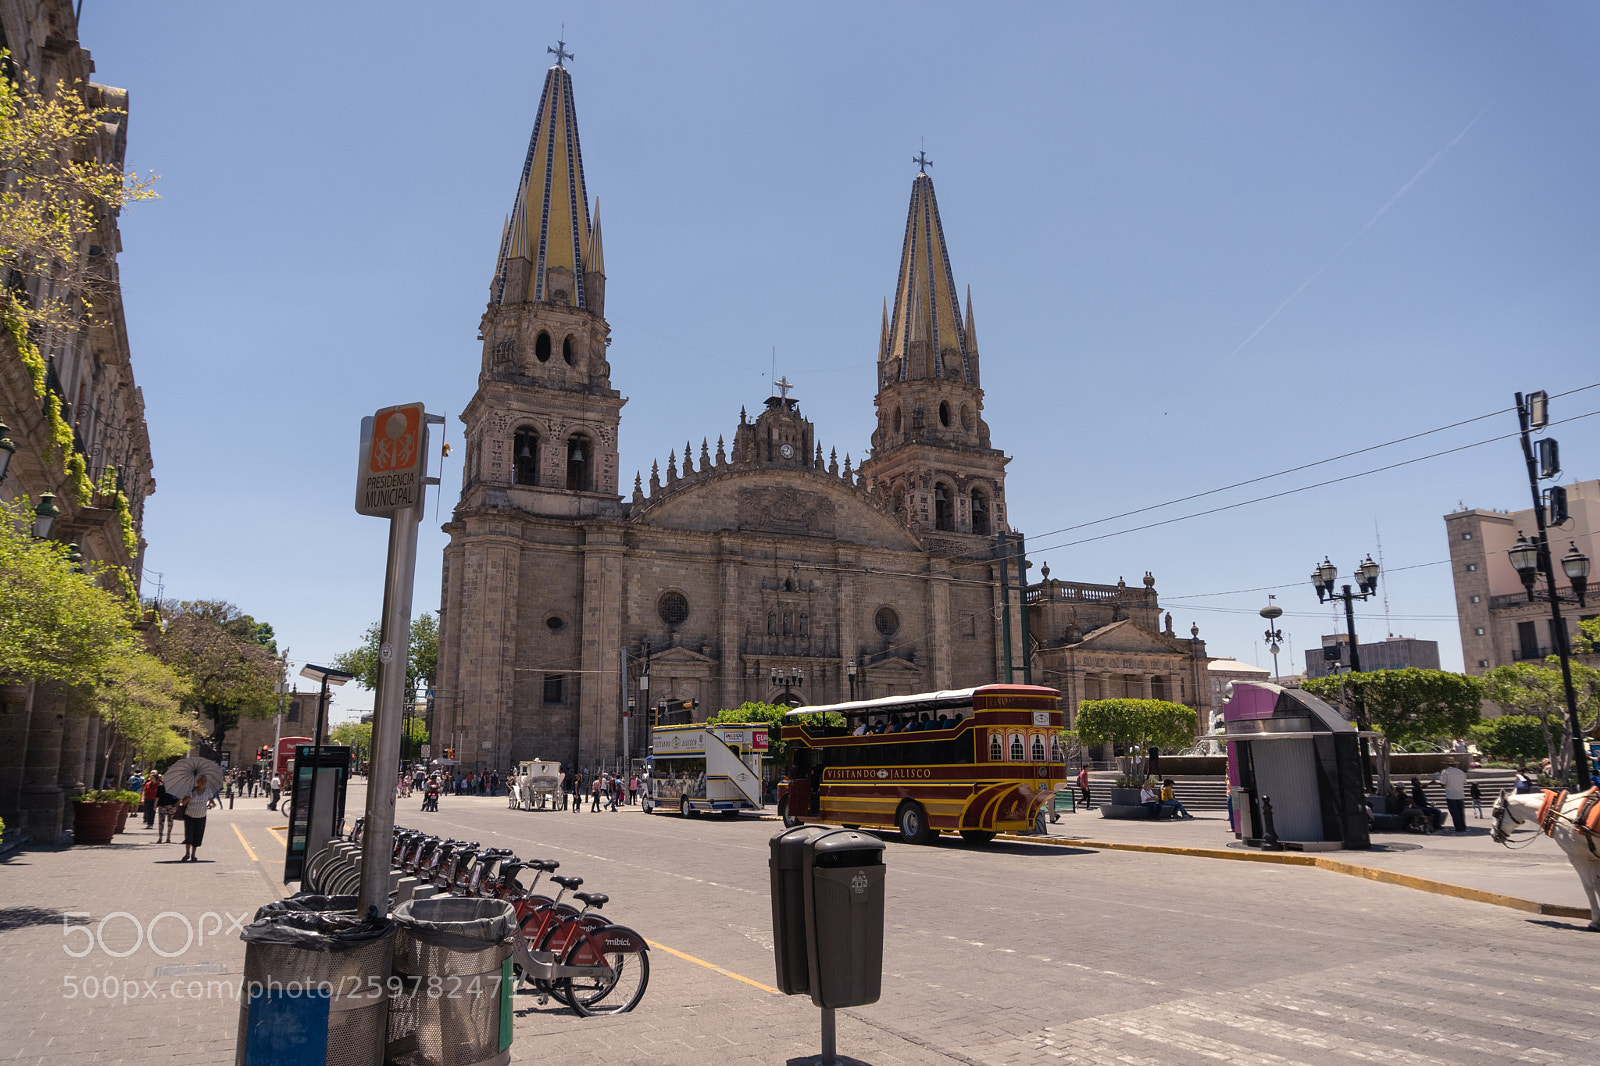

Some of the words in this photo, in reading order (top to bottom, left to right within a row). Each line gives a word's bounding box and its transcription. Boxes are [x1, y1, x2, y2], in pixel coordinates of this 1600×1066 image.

[367, 472, 415, 490] PRESIDENCIA
[365, 487, 413, 508] MUNICIPAL
[827, 769, 876, 778] VISITANDO
[890, 768, 931, 779] JALISCO
[605, 937, 631, 946] mibici
